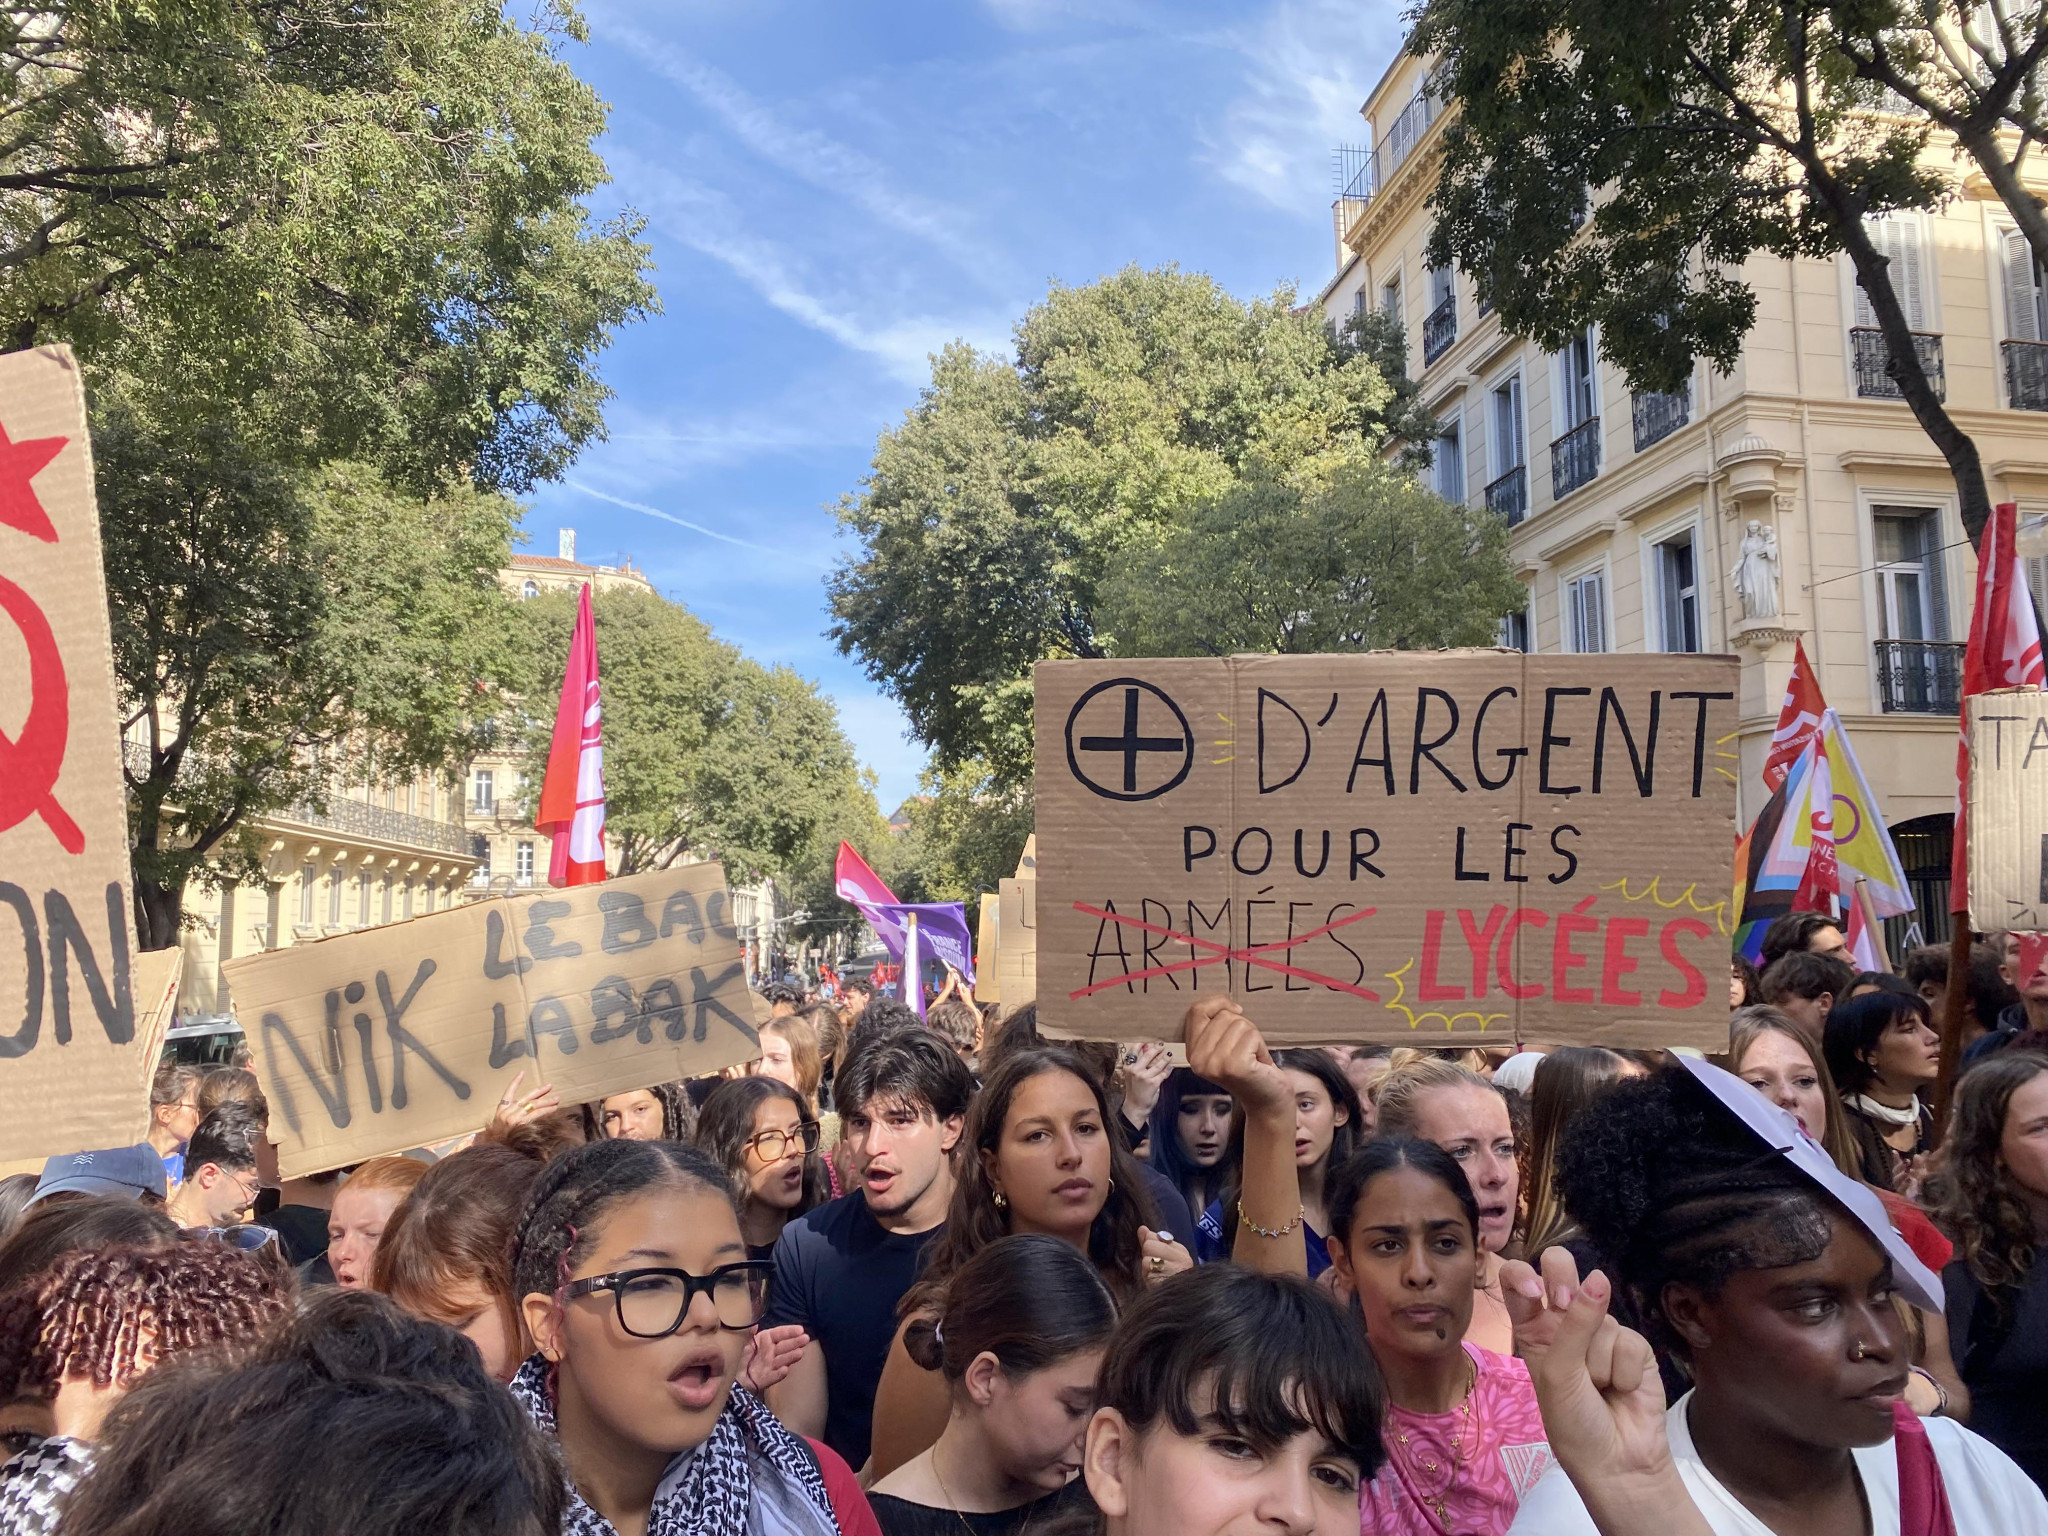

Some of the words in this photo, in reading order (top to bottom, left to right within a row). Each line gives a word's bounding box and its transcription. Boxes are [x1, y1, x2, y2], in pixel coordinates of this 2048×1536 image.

[1258, 686, 1735, 798] D'ARGENT
[1184, 826, 1386, 880] POUR
[1455, 823, 1583, 884] LES
[483, 900, 583, 981] LE
[598, 890, 738, 955] BAC
[1086, 886, 1367, 997] ARMÉES
[1418, 895, 1713, 1010] LYCÉES
